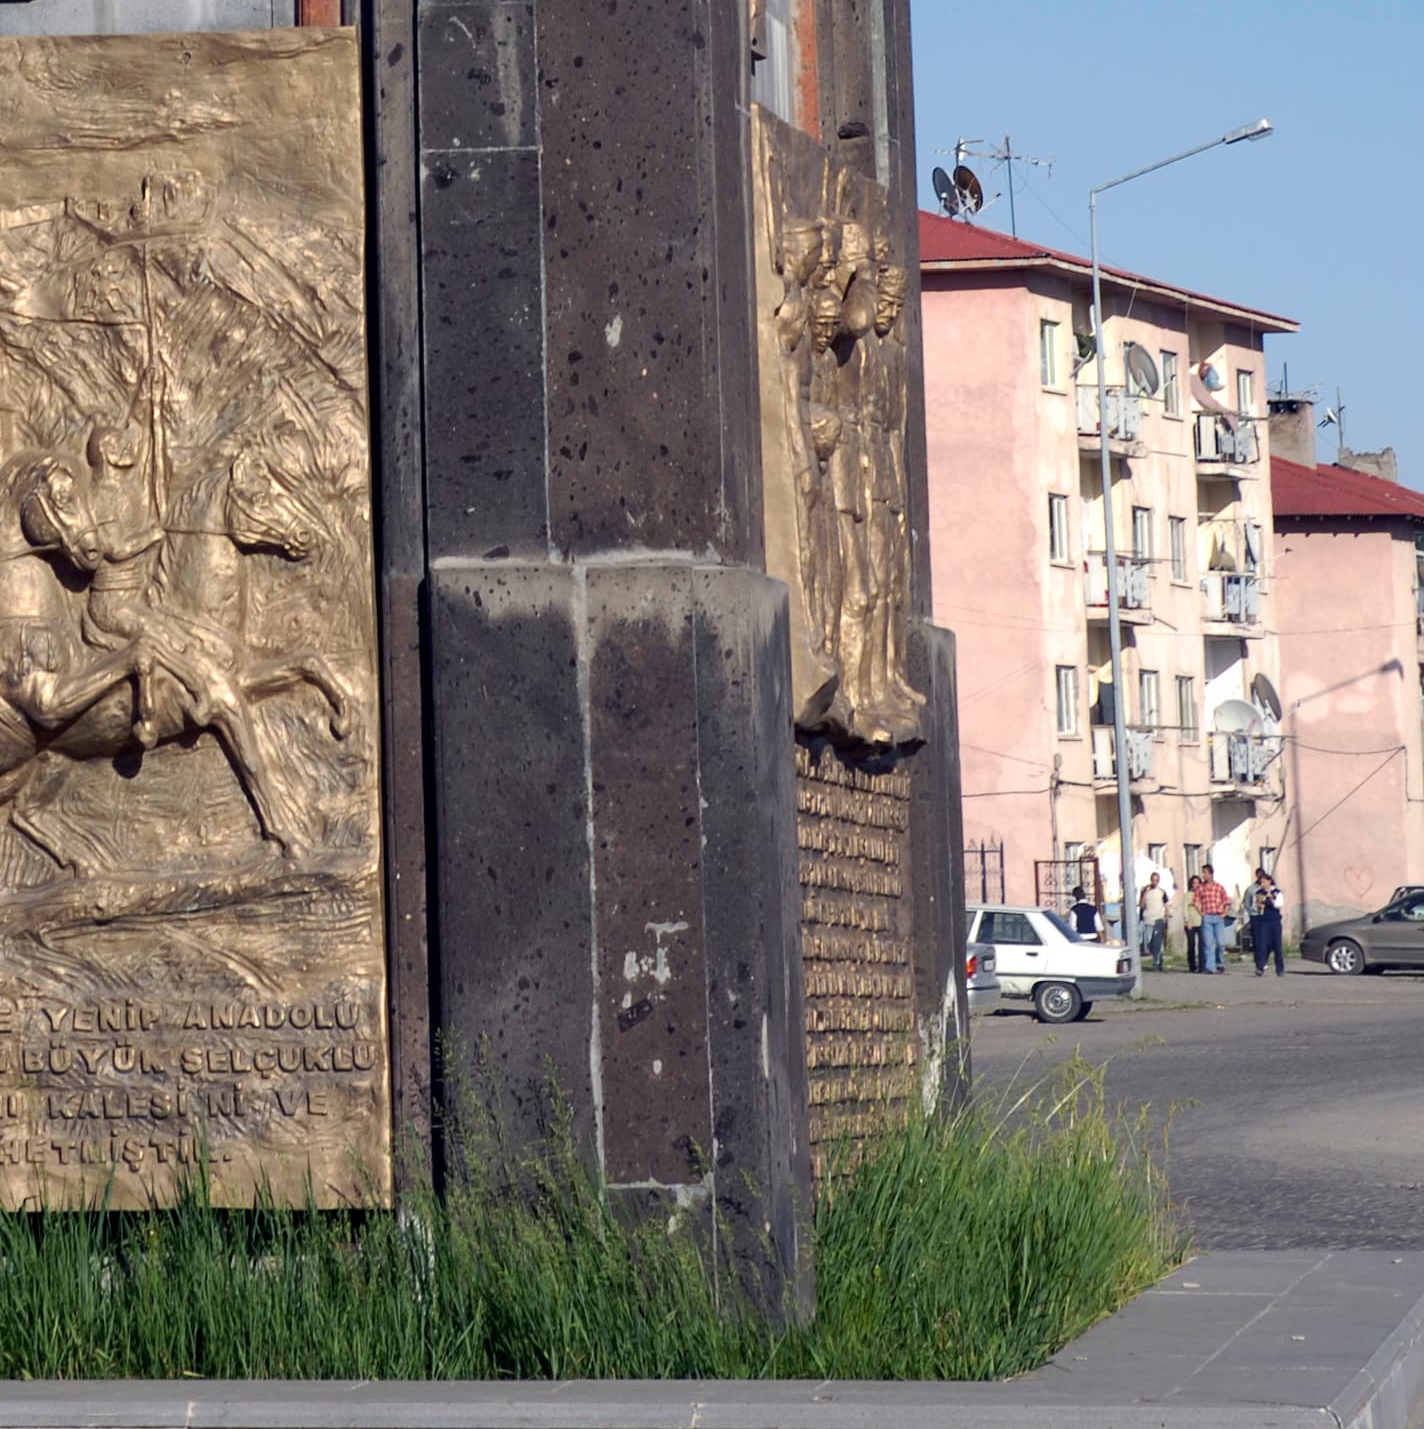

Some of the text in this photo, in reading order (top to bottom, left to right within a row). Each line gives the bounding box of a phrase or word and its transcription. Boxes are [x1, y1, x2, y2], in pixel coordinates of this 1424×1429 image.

[42, 999, 159, 1031] YENİP
[183, 1003, 360, 1030] ANADOLU
[23, 1038, 166, 1075] BÜYÜK
[180, 1043, 375, 1079] SELÇUKLU
[275, 1089, 327, 1116] VE
